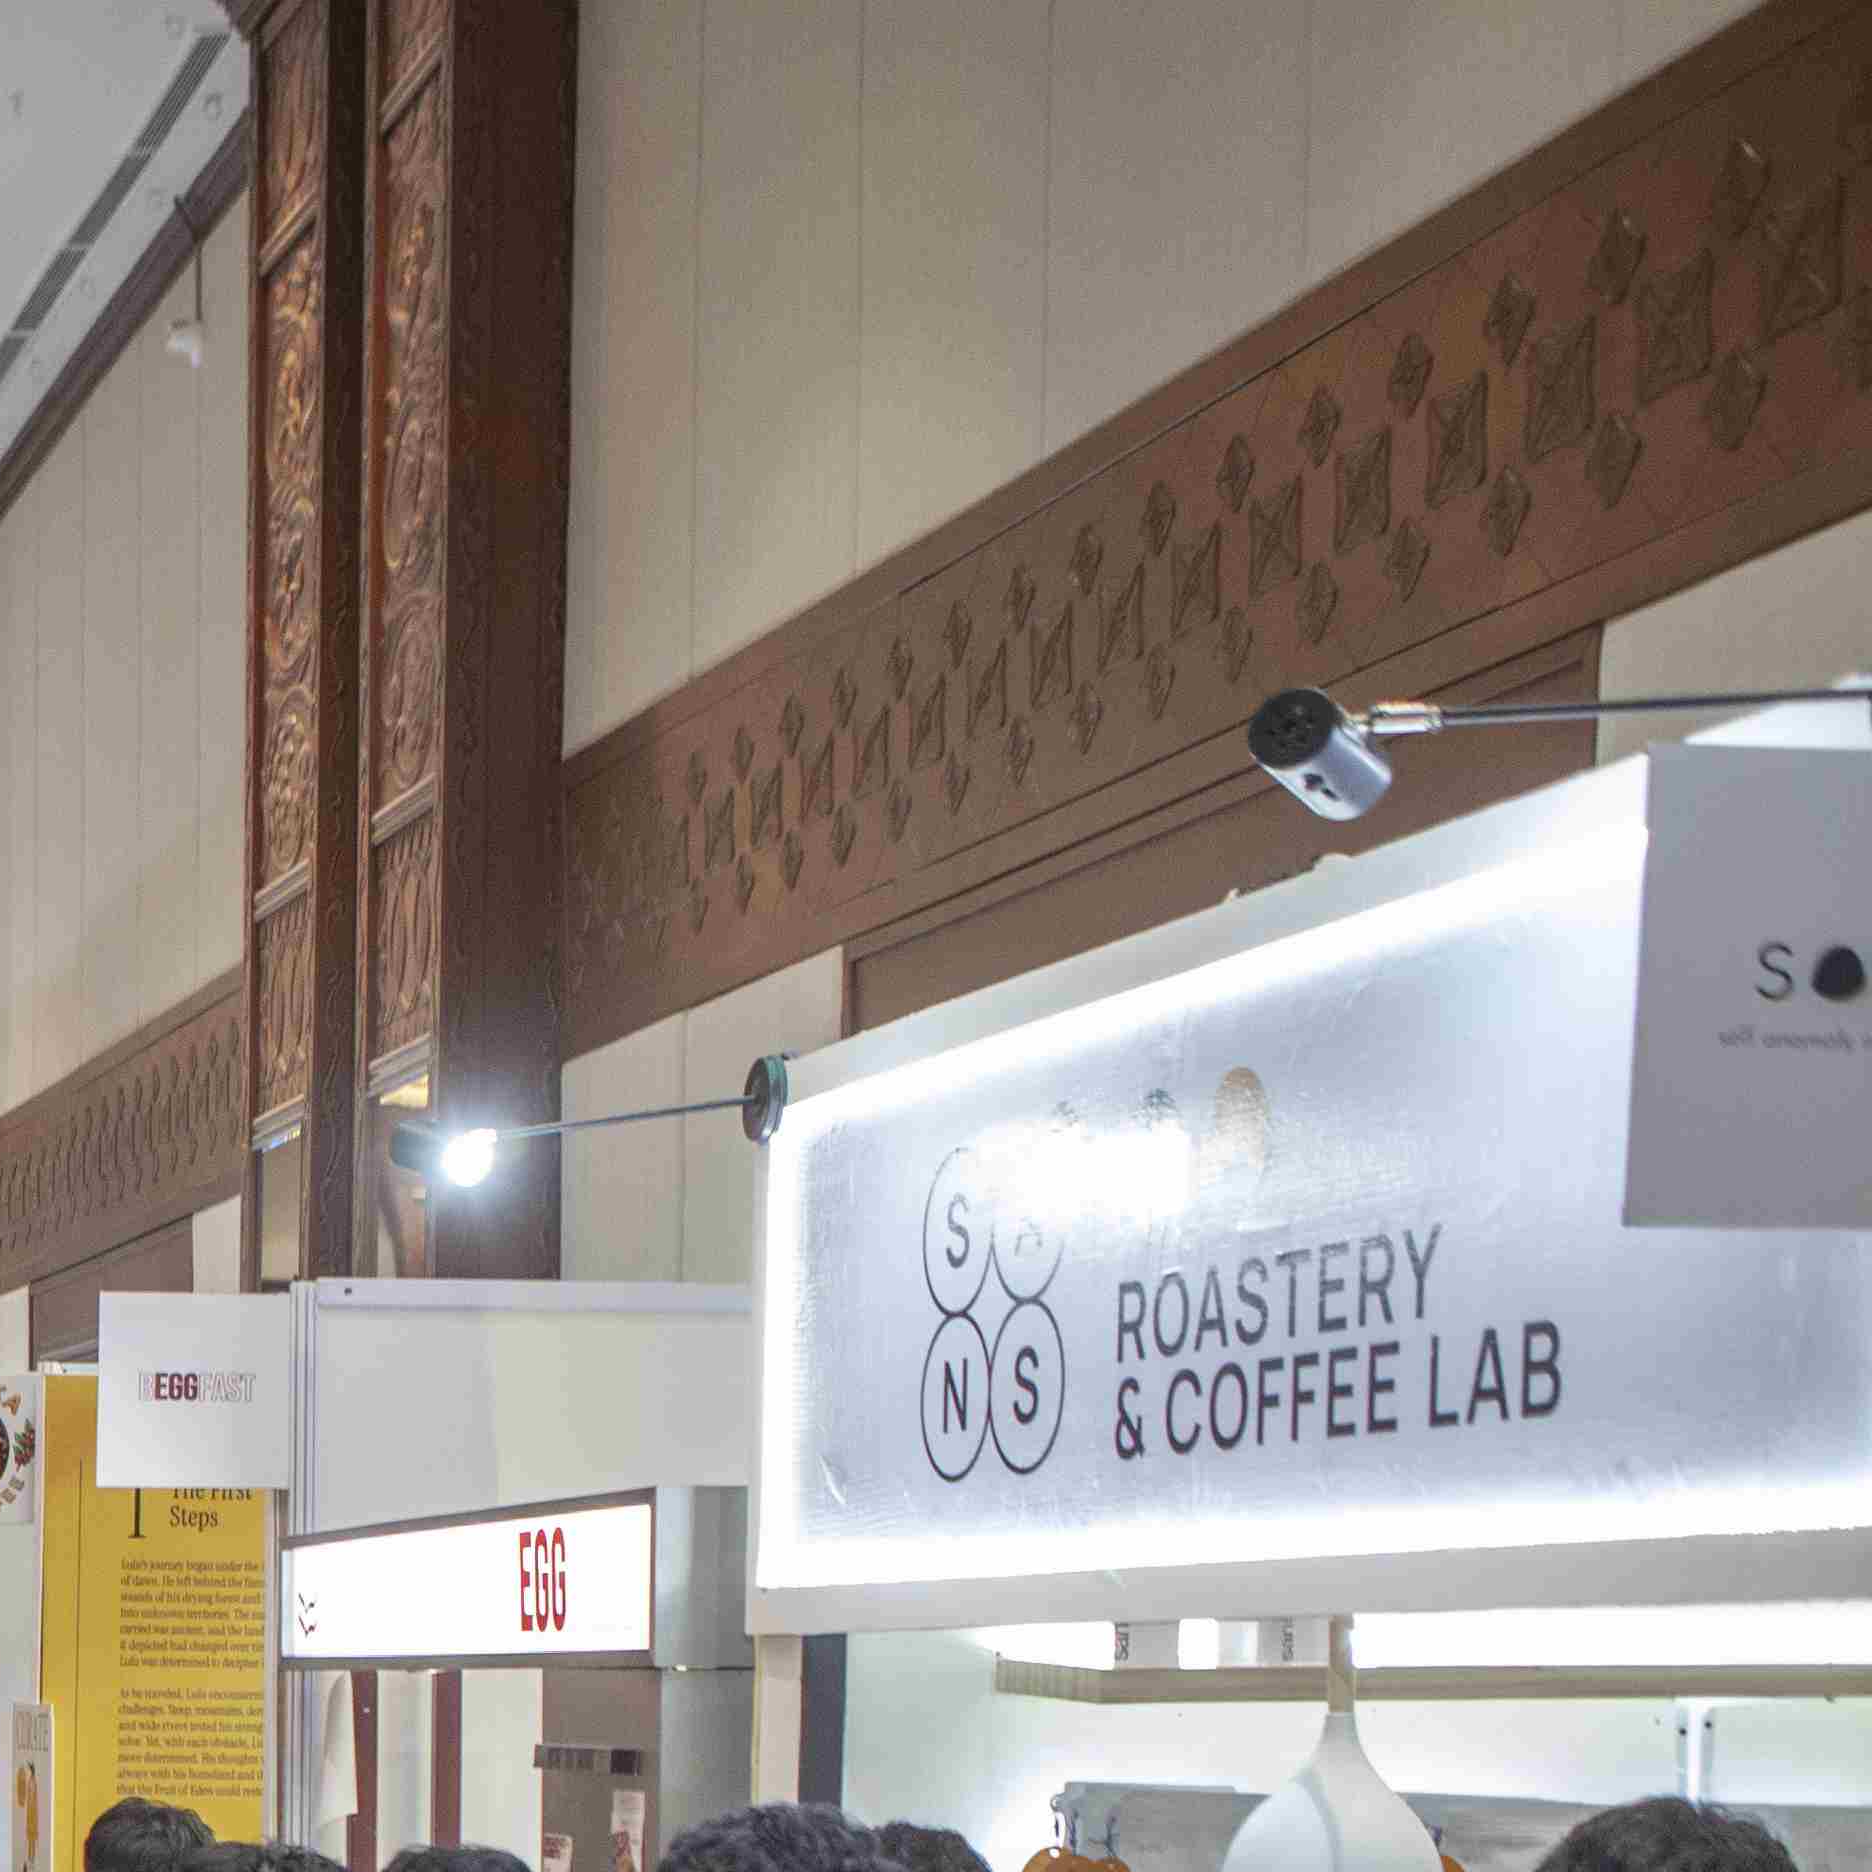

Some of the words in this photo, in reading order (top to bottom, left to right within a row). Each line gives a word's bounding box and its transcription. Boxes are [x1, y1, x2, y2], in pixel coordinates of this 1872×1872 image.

[1117, 1222, 1443, 1364] ROASTERY
[1115, 1376, 1145, 1460] &
[1165, 1341, 1400, 1455] COFFEE
[1431, 1320, 1563, 1430] LAB
[169, 1505, 219, 1533] Steps
[519, 1527, 567, 1632] EGG
